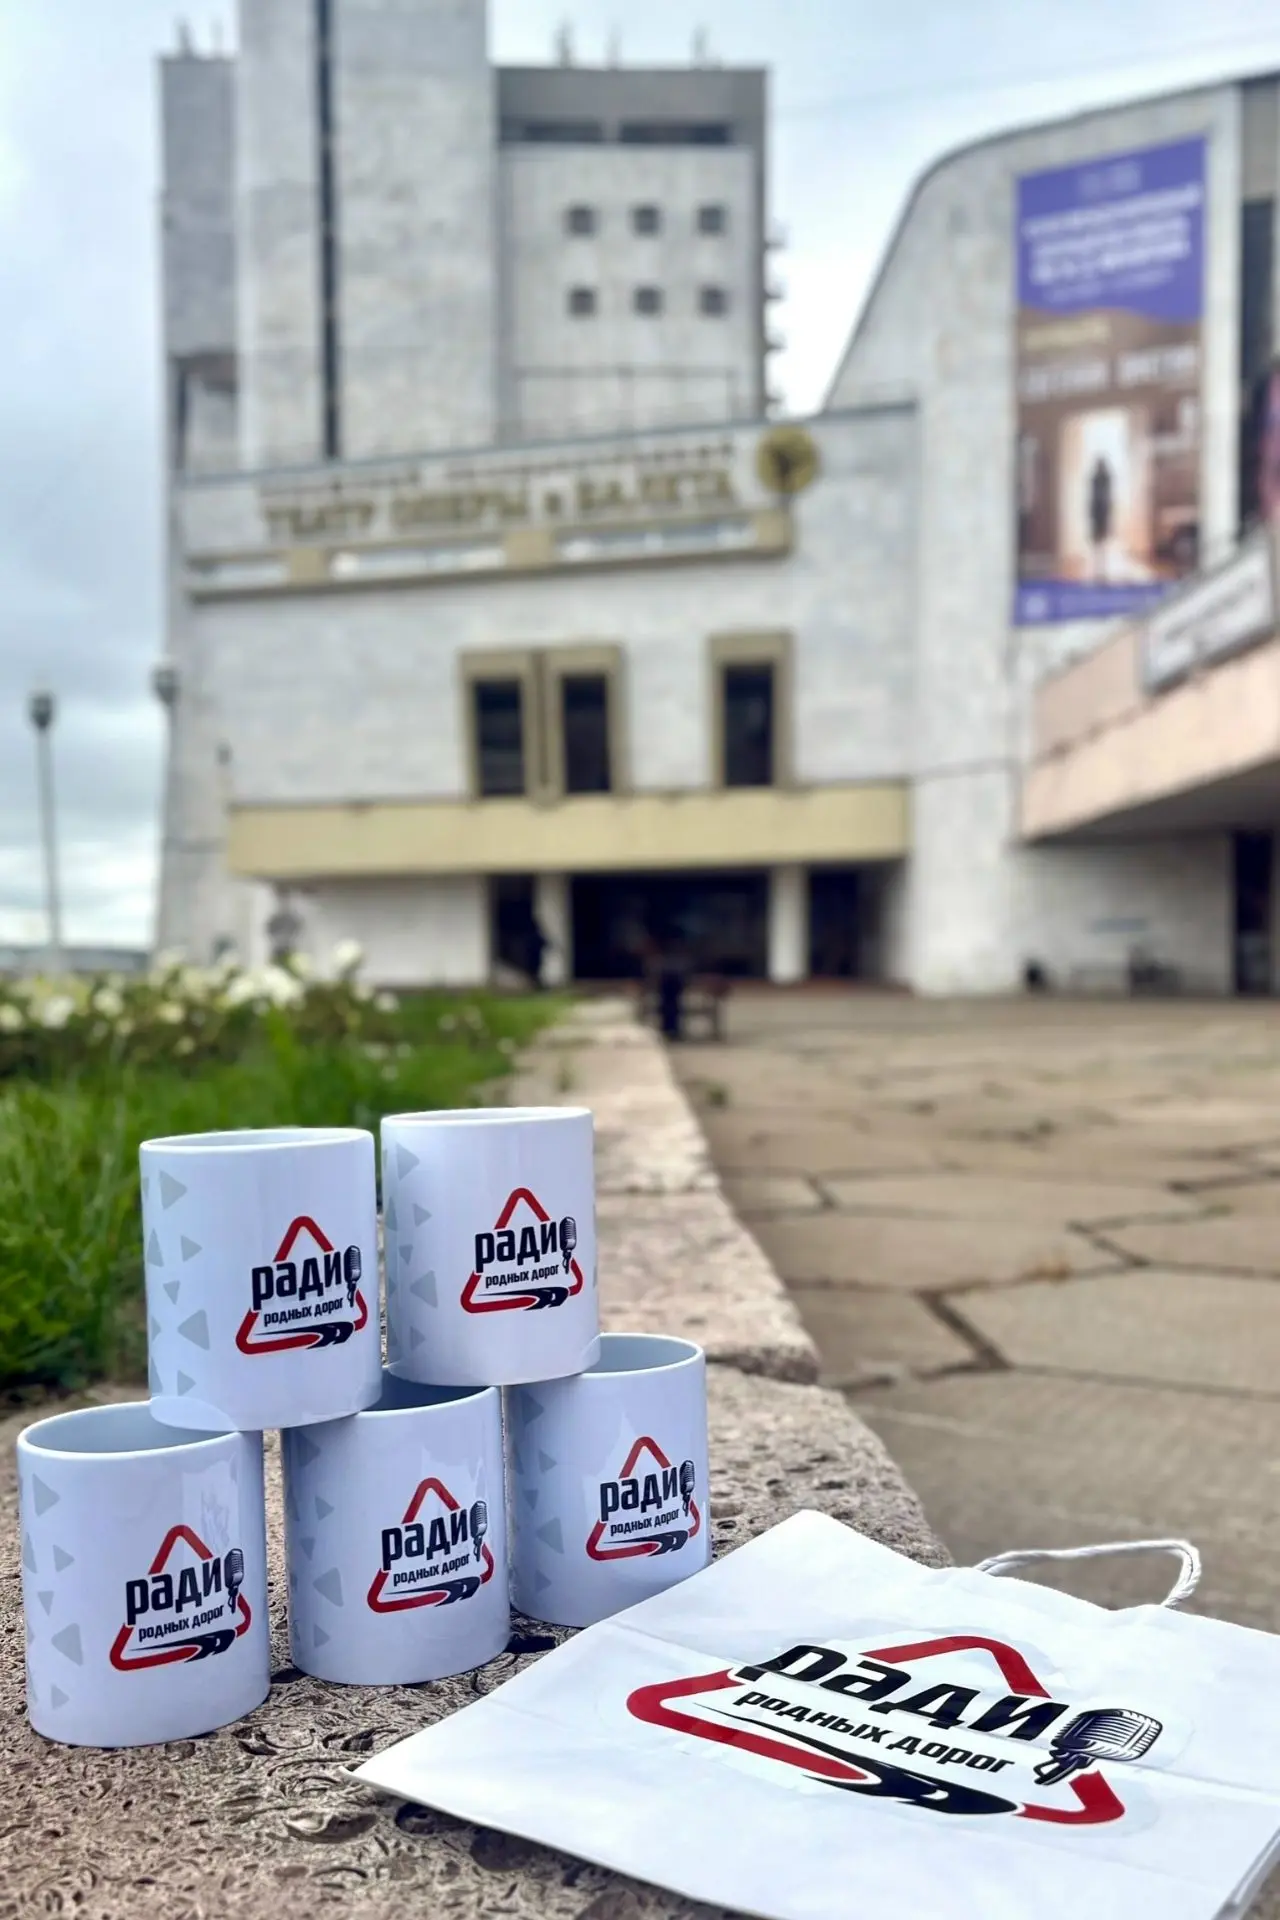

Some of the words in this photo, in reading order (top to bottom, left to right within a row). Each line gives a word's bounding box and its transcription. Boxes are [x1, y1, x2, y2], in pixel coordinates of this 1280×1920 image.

[485, 1271, 529, 1288] родных
[531, 1264, 559, 1282] дорог
[264, 1304, 312, 1327] родных
[314, 1297, 344, 1317] дорог
[610, 1517, 652, 1537] родных
[654, 1509, 680, 1528] дорог
[393, 1565, 439, 1587] родных
[441, 1553, 470, 1575] дорог
[138, 1618, 189, 1643] родных
[192, 1604, 225, 1629] дорог
[734, 1691, 893, 1743] родных
[886, 1735, 1015, 1773] дорог
